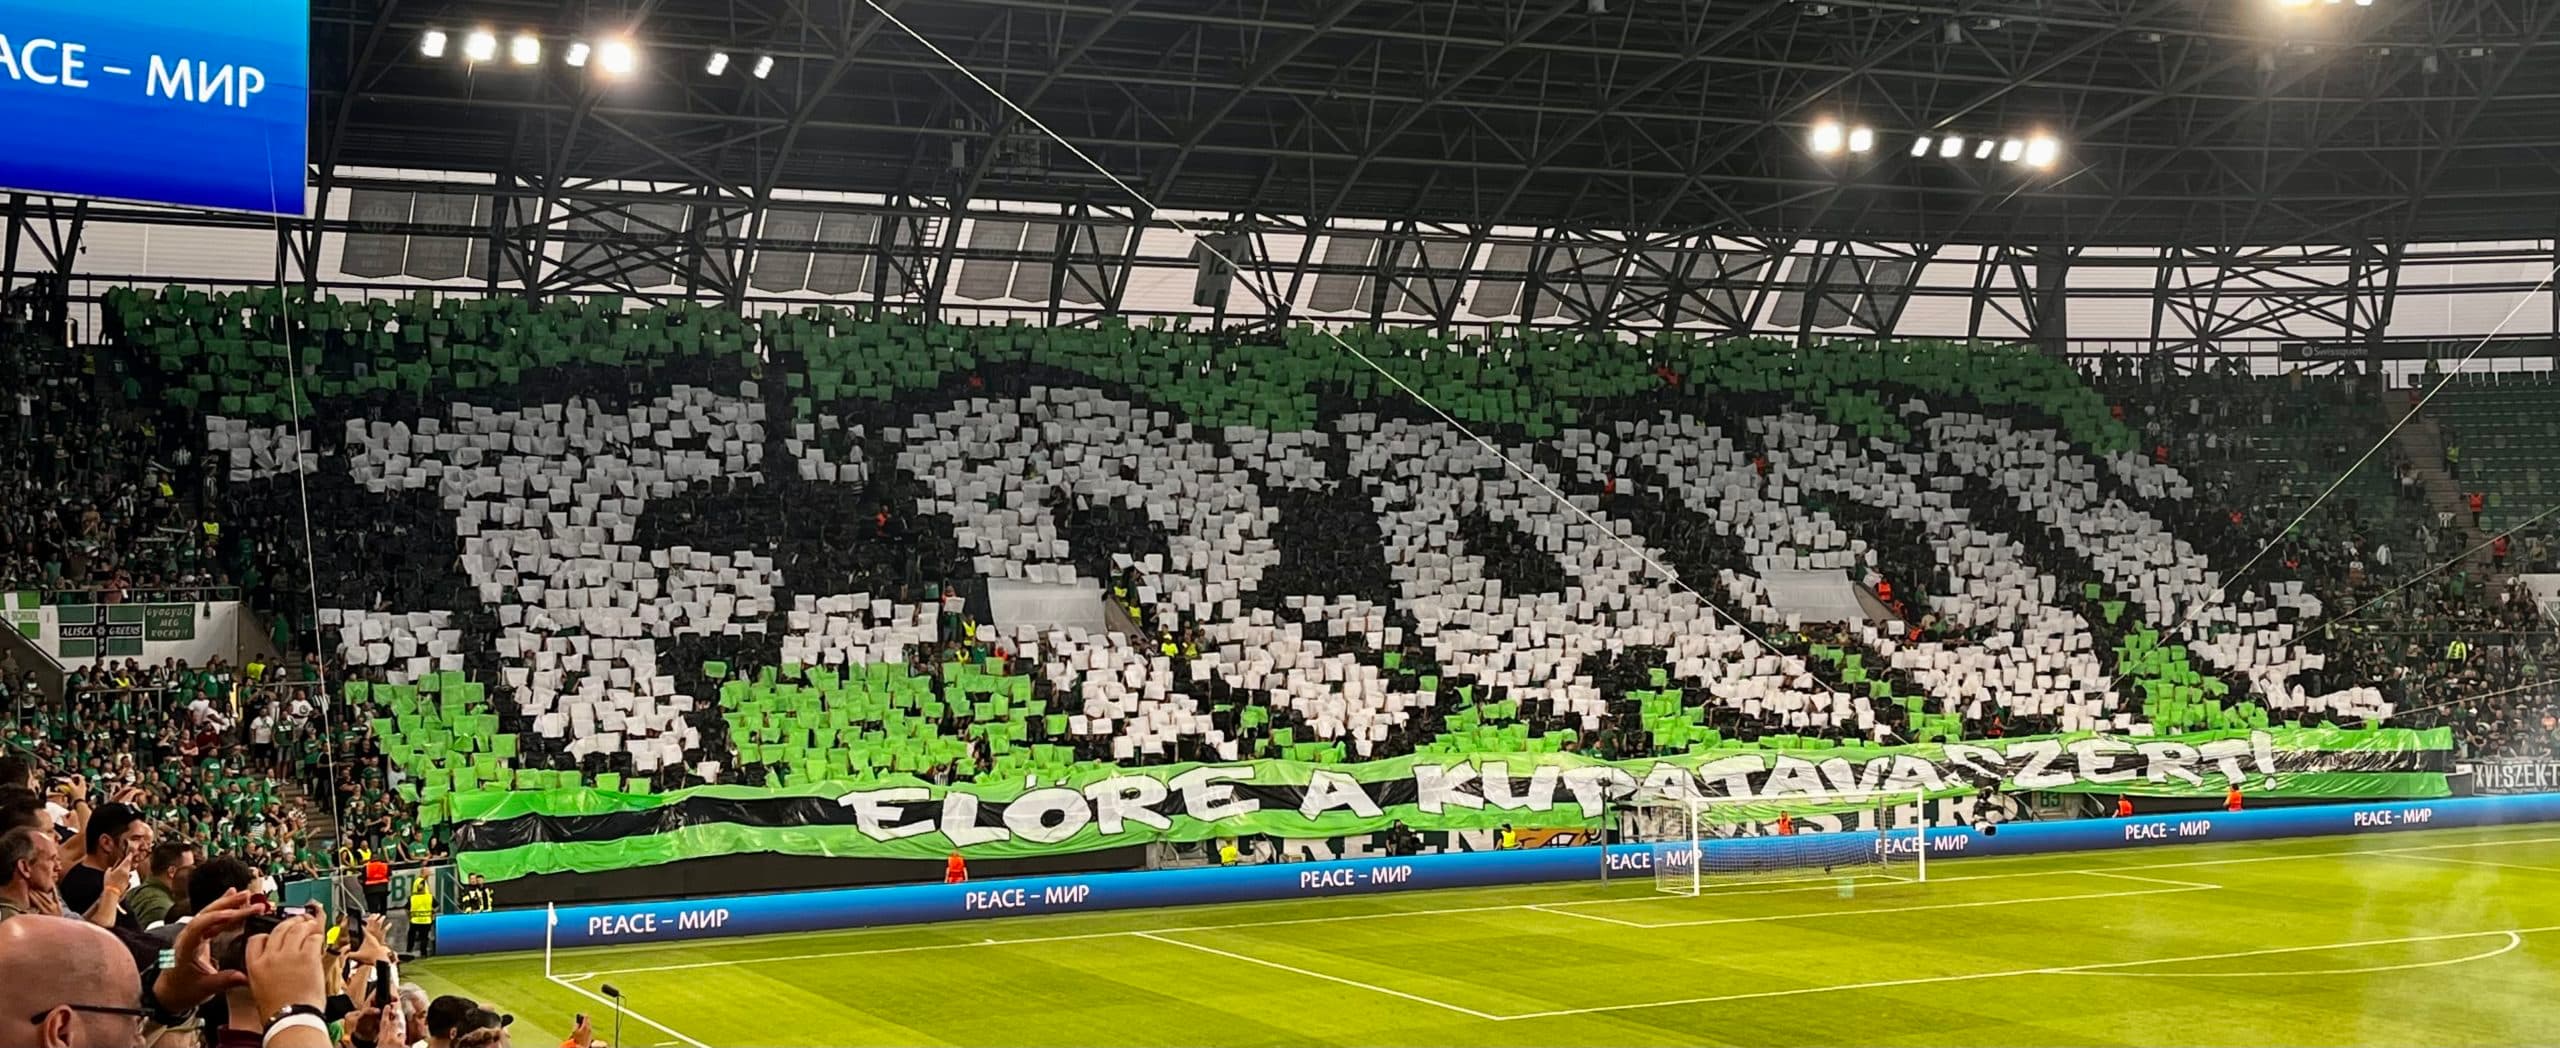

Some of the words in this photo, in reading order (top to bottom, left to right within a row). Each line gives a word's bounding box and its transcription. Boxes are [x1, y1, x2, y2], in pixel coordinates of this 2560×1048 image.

[146, 54, 265, 108] МИР
[2313, 346, 2369, 358] Swissquote
[61, 627, 94, 637] ALISCA
[109, 626, 141, 635] GREENS
[1299, 769, 1386, 822] A
[2354, 810, 2392, 826] PEACE
[2403, 808, 2432, 824] МИР
[2125, 824, 2166, 840] PEACE
[2179, 820, 2210, 837] МИР
[1934, 834, 1968, 851] МИР
[1300, 868, 1354, 889] PEACE
[1371, 865, 1412, 885] МИР
[965, 888, 1026, 911] PEACE
[1045, 884, 1090, 905] МИР
[588, 913, 657, 936] PEACE
[678, 908, 729, 930] МИР
